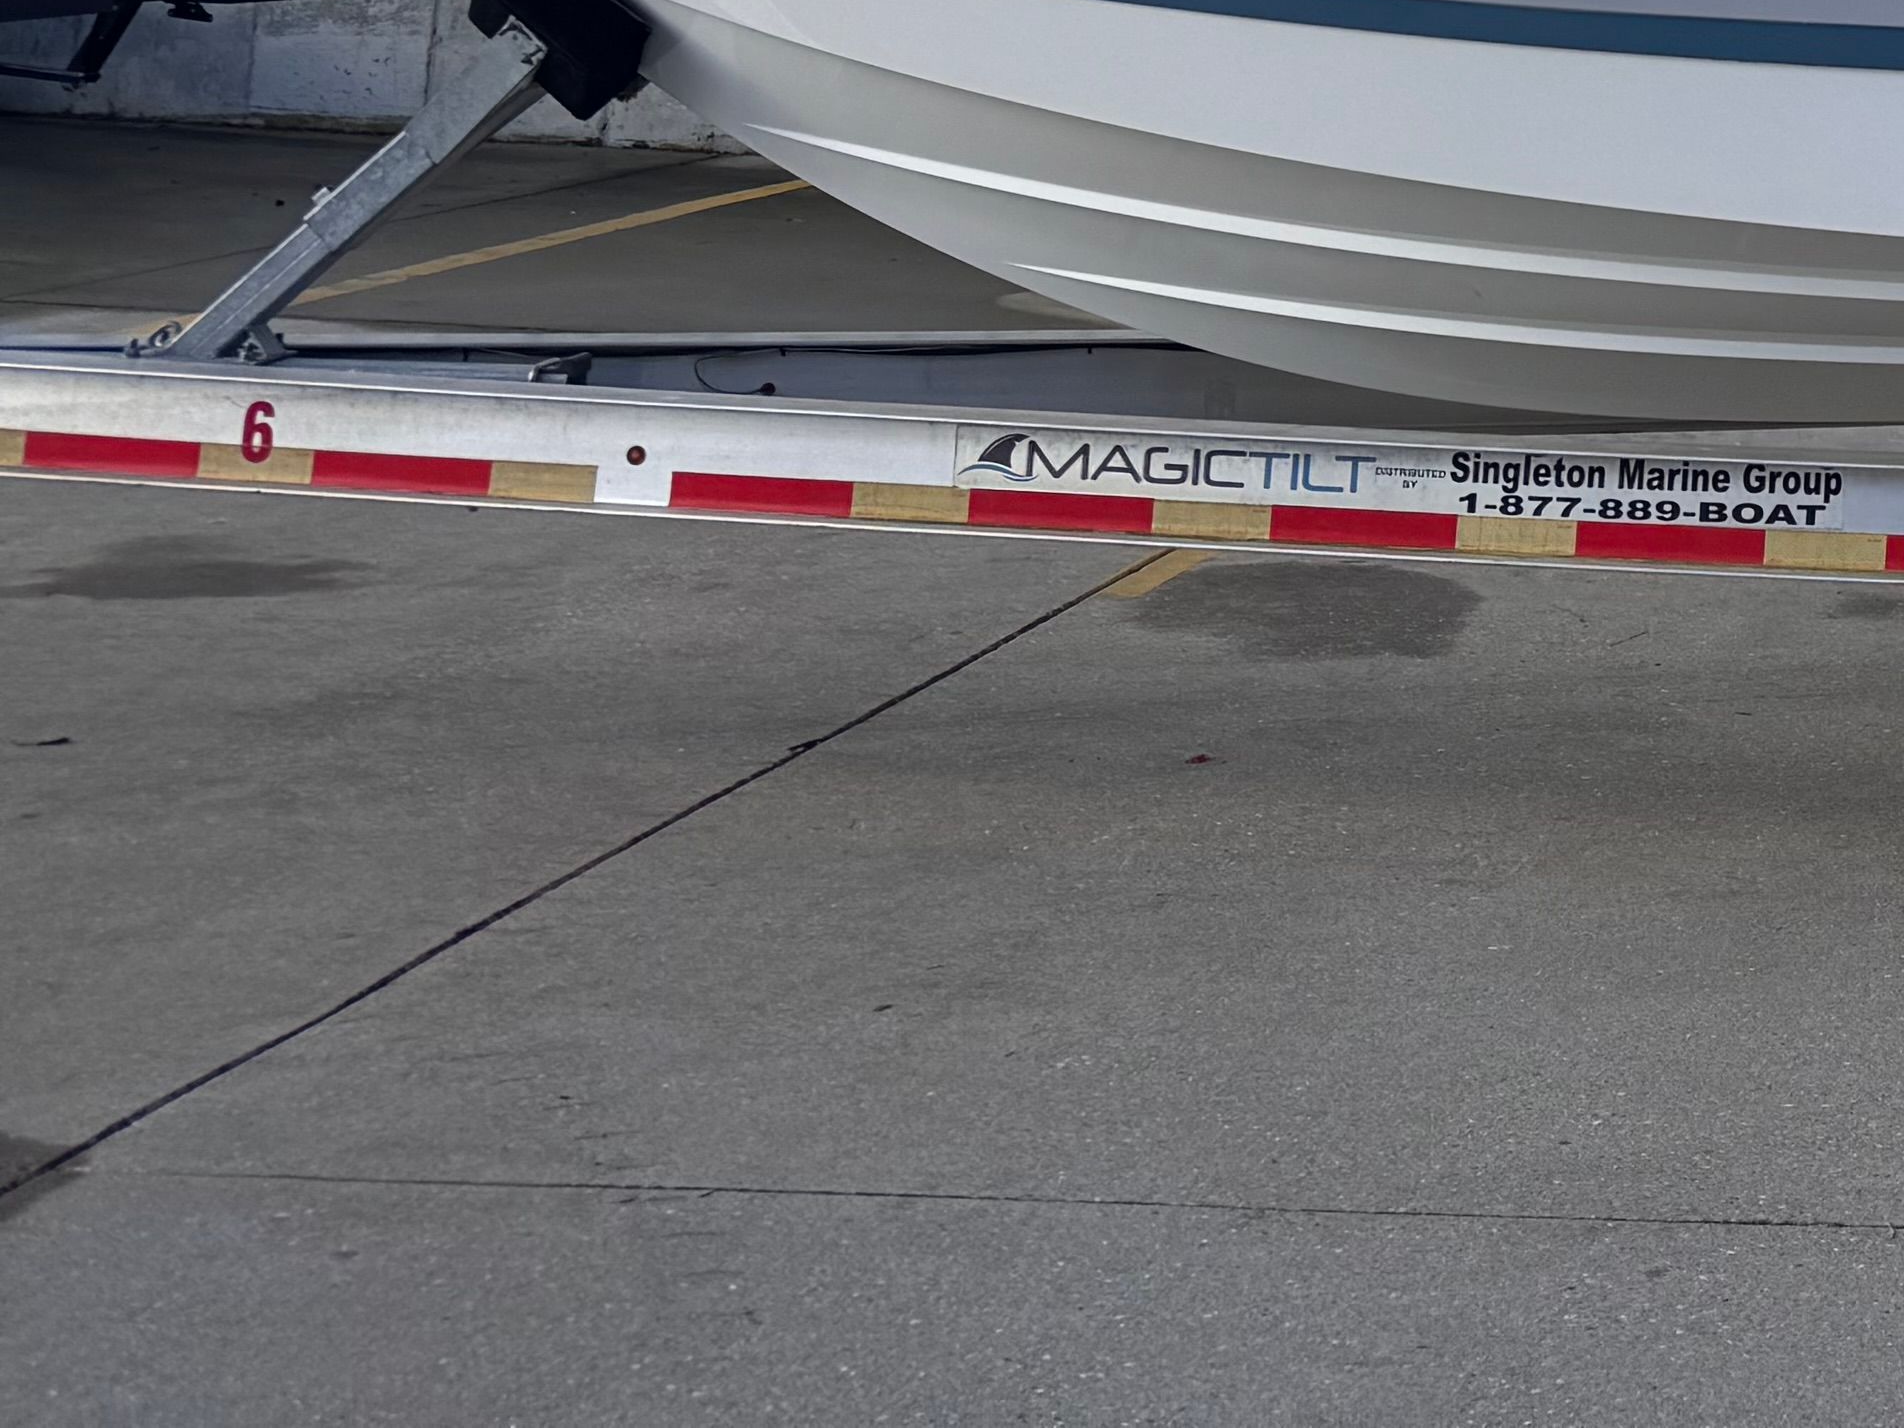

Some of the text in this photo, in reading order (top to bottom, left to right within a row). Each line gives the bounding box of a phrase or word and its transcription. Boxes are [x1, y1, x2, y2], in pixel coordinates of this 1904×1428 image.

[241, 400, 275, 464] 6
[1025, 440, 1377, 494] MAGICTILT
[1375, 466, 1447, 479] DISTRIBUTED
[1402, 479, 1418, 489] BY
[1450, 451, 1843, 504] Singleton Marine Group
[1458, 492, 1827, 526] 1-877-889-BOAT
